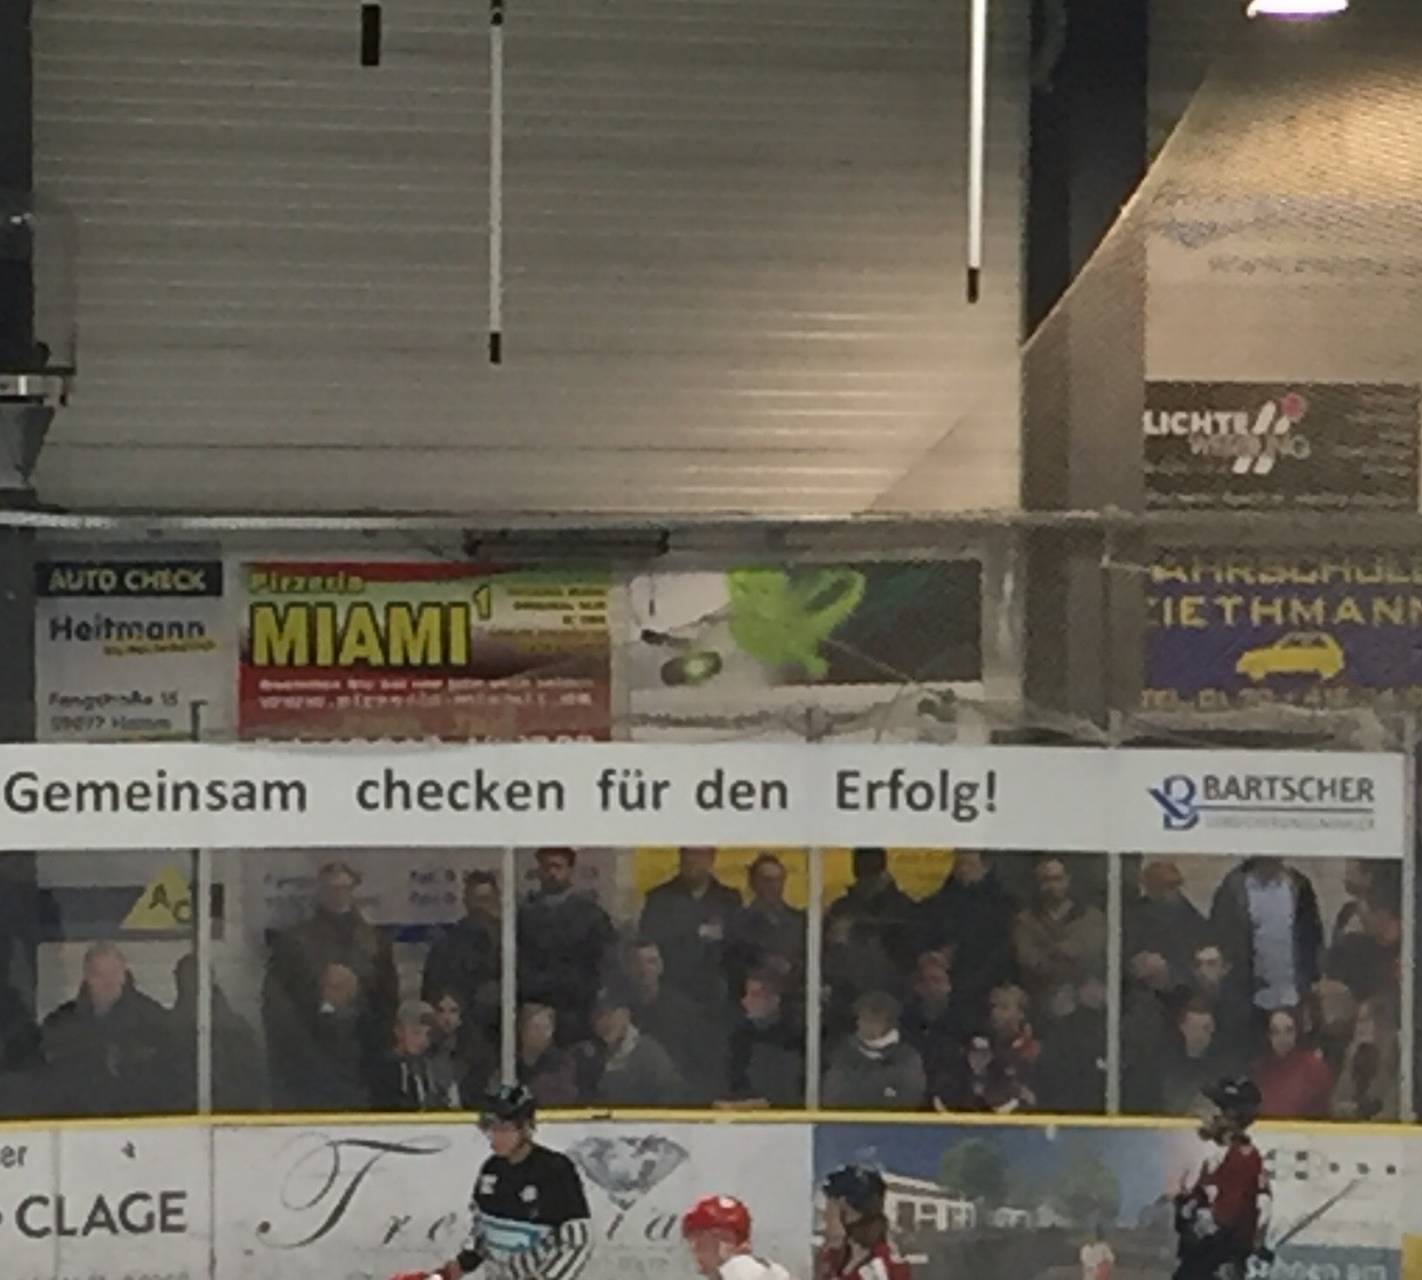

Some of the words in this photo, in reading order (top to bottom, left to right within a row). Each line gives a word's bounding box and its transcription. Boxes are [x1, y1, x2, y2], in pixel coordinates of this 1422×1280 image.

[49, 567, 117, 592] AUTO
[124, 566, 207, 592] CHECK
[49, 612, 206, 642] Heitmann
[250, 602, 471, 668] MIAMI
[3, 769, 308, 814] Gemeinsam
[356, 767, 564, 812] checken
[598, 768, 670, 811] für
[695, 767, 788, 811] den
[836, 768, 997, 823] Erfolg!
[1202, 774, 1376, 802] BARTSCHER
[15, 1190, 188, 1239] CLAGE
